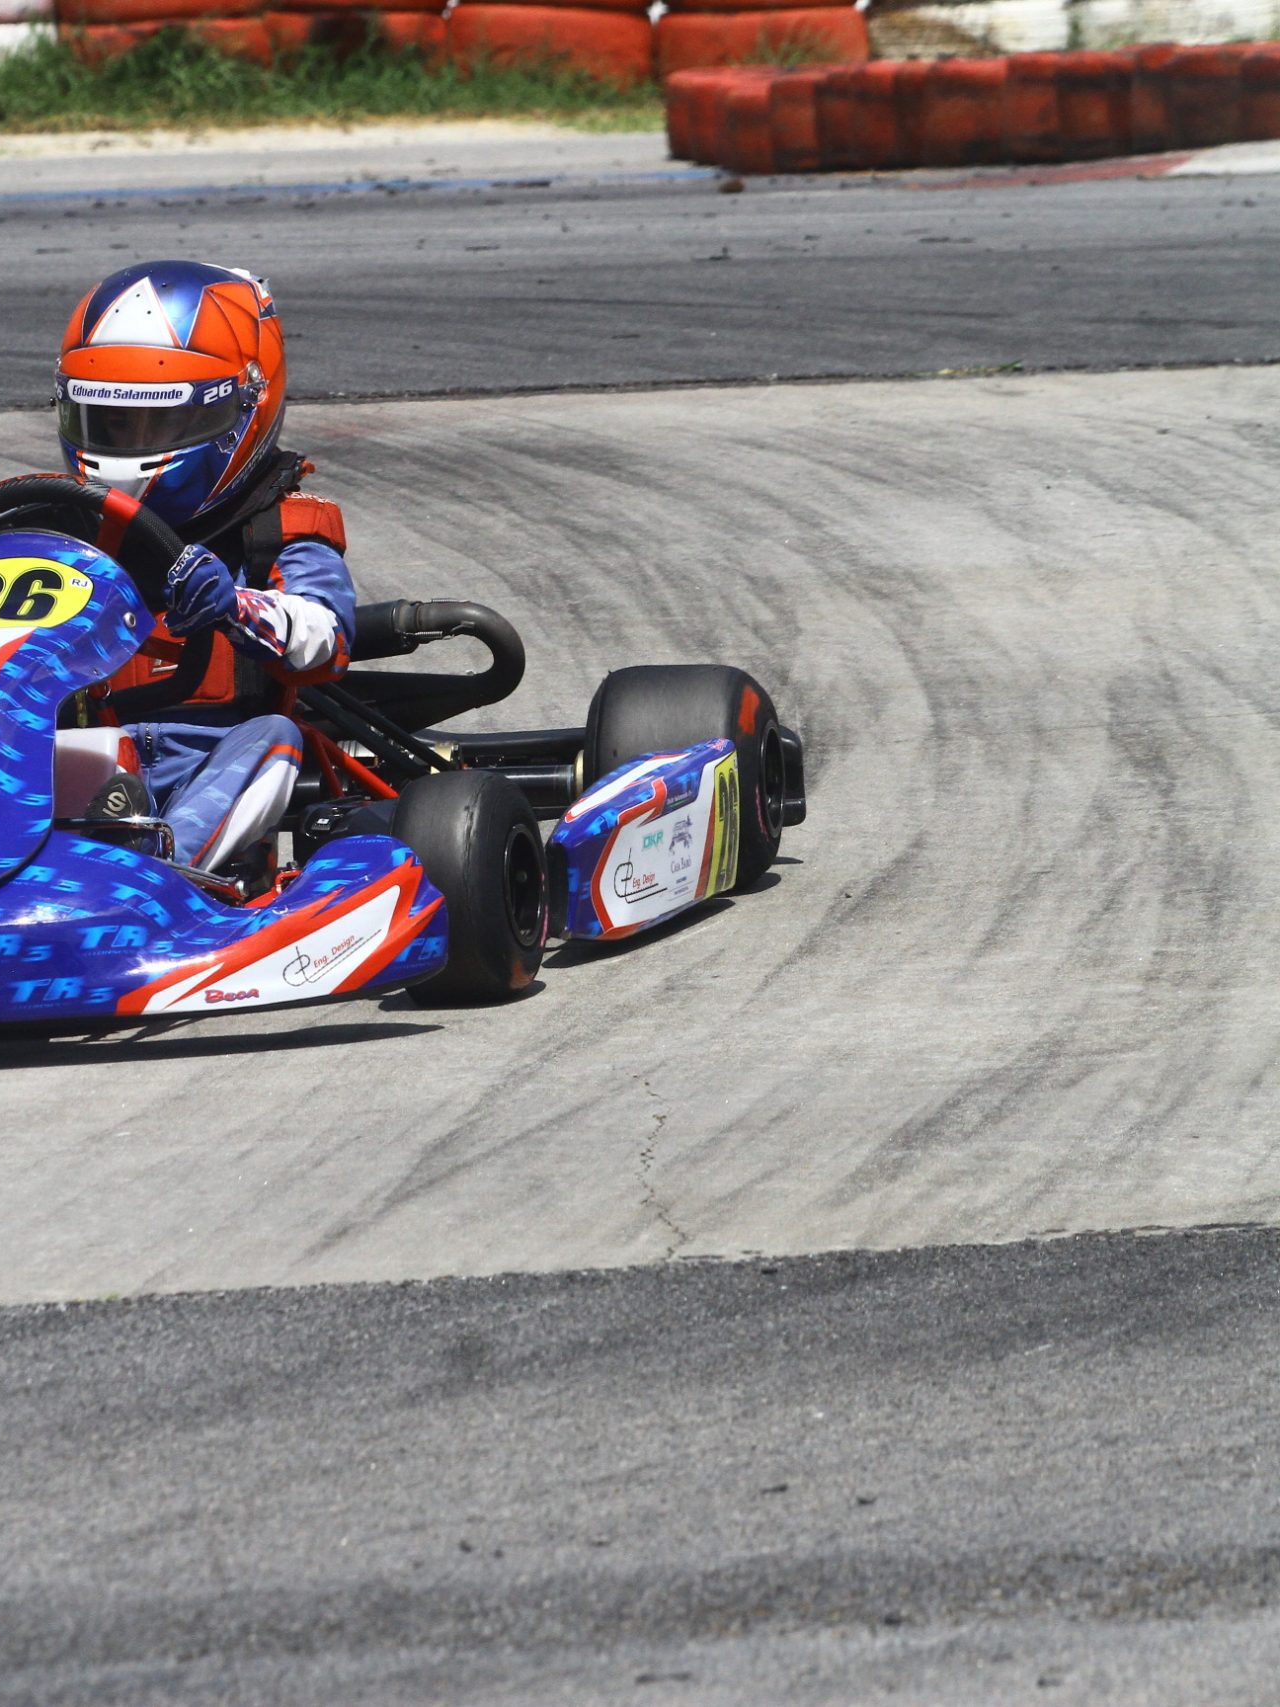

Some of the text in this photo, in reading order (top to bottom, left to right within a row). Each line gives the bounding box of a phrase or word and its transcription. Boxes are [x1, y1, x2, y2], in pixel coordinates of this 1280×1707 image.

[72, 384, 183, 400] Eduardo Salamonde
[203, 379, 233, 405] 26
[71, 578, 88, 588] RJ
[313, 935, 355, 968] Eng. Design
